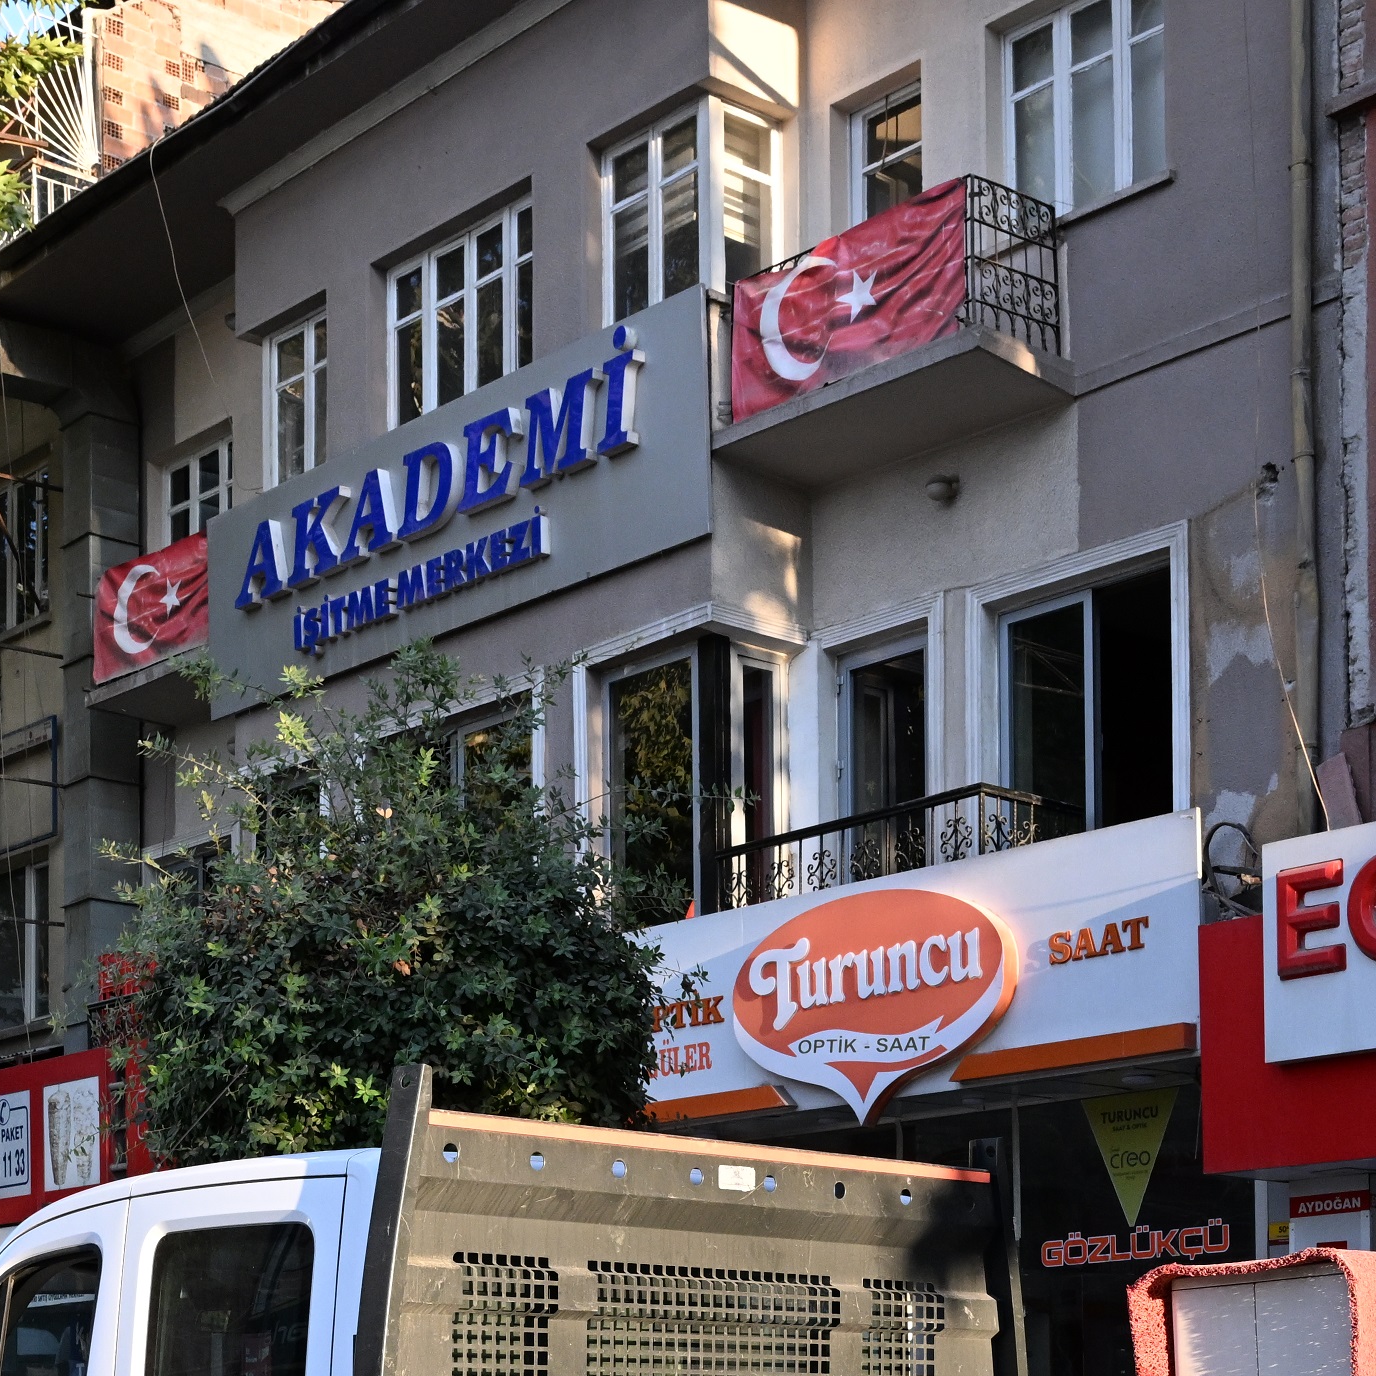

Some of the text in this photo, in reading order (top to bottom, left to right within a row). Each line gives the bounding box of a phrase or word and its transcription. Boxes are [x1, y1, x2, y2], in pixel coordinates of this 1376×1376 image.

[235, 325, 645, 611] AKADEMİ
[294, 505, 550, 655] İŞİTME MERKEZİ
[1048, 916, 1149, 966] SAAT
[749, 926, 983, 1032] Turuncu
[652, 990, 725, 1033] PTİK
[798, 1035, 857, 1056] OPTİK
[876, 1035, 931, 1053] SAAT
[1, 1125, 24, 1143] PAKET
[1101, 1106, 1159, 1124] TURUNCU
[3, 1151, 12, 1178] 11
[14, 1148, 25, 1177] 33
[1298, 1196, 1361, 1214] AYDOĞAN
[1040, 1218, 1230, 1268] GÖZLÜKÇÜ
